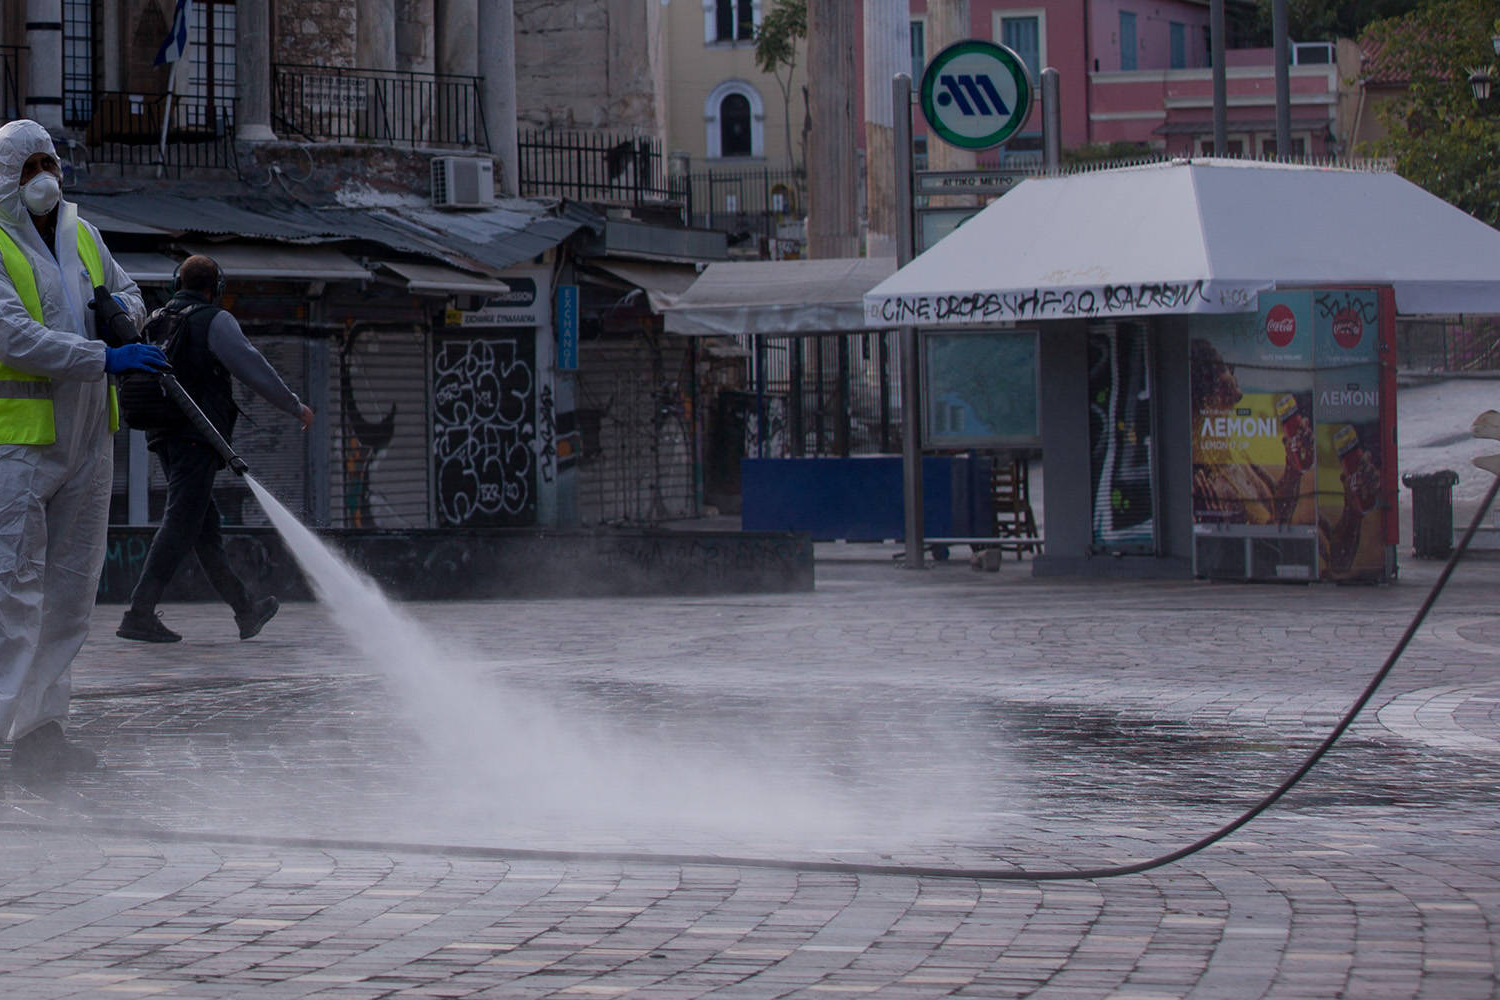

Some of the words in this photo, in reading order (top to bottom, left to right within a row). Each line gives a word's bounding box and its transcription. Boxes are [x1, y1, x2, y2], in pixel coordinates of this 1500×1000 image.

[563, 288, 573, 369] EXCHANGE
[1201, 417, 1277, 438] ΛΕΜΟΝΙ
[1200, 440, 1228, 450] LEMON
